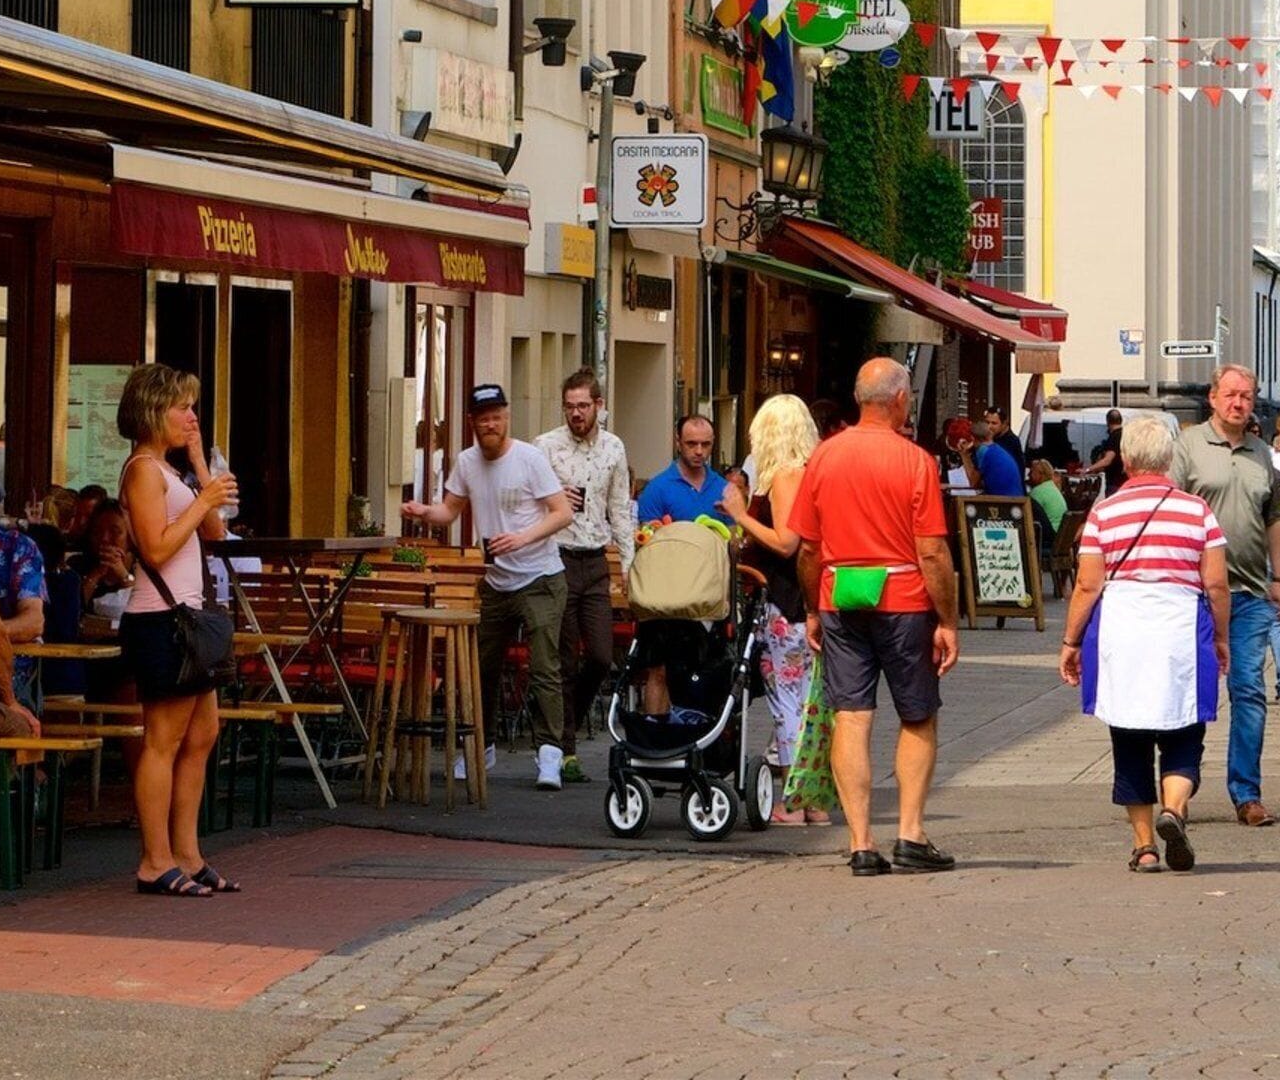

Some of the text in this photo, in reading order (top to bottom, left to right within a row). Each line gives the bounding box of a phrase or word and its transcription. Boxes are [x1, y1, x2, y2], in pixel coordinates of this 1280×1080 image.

[860, 0, 896, 18] TEL
[930, 90, 979, 131] TEL
[617, 146, 699, 158] CASITA MEXICANA
[972, 212, 999, 228] ISH
[197, 205, 257, 258] Pizzeria
[438, 242, 487, 284] Ristorante
[967, 233, 995, 250] UB
